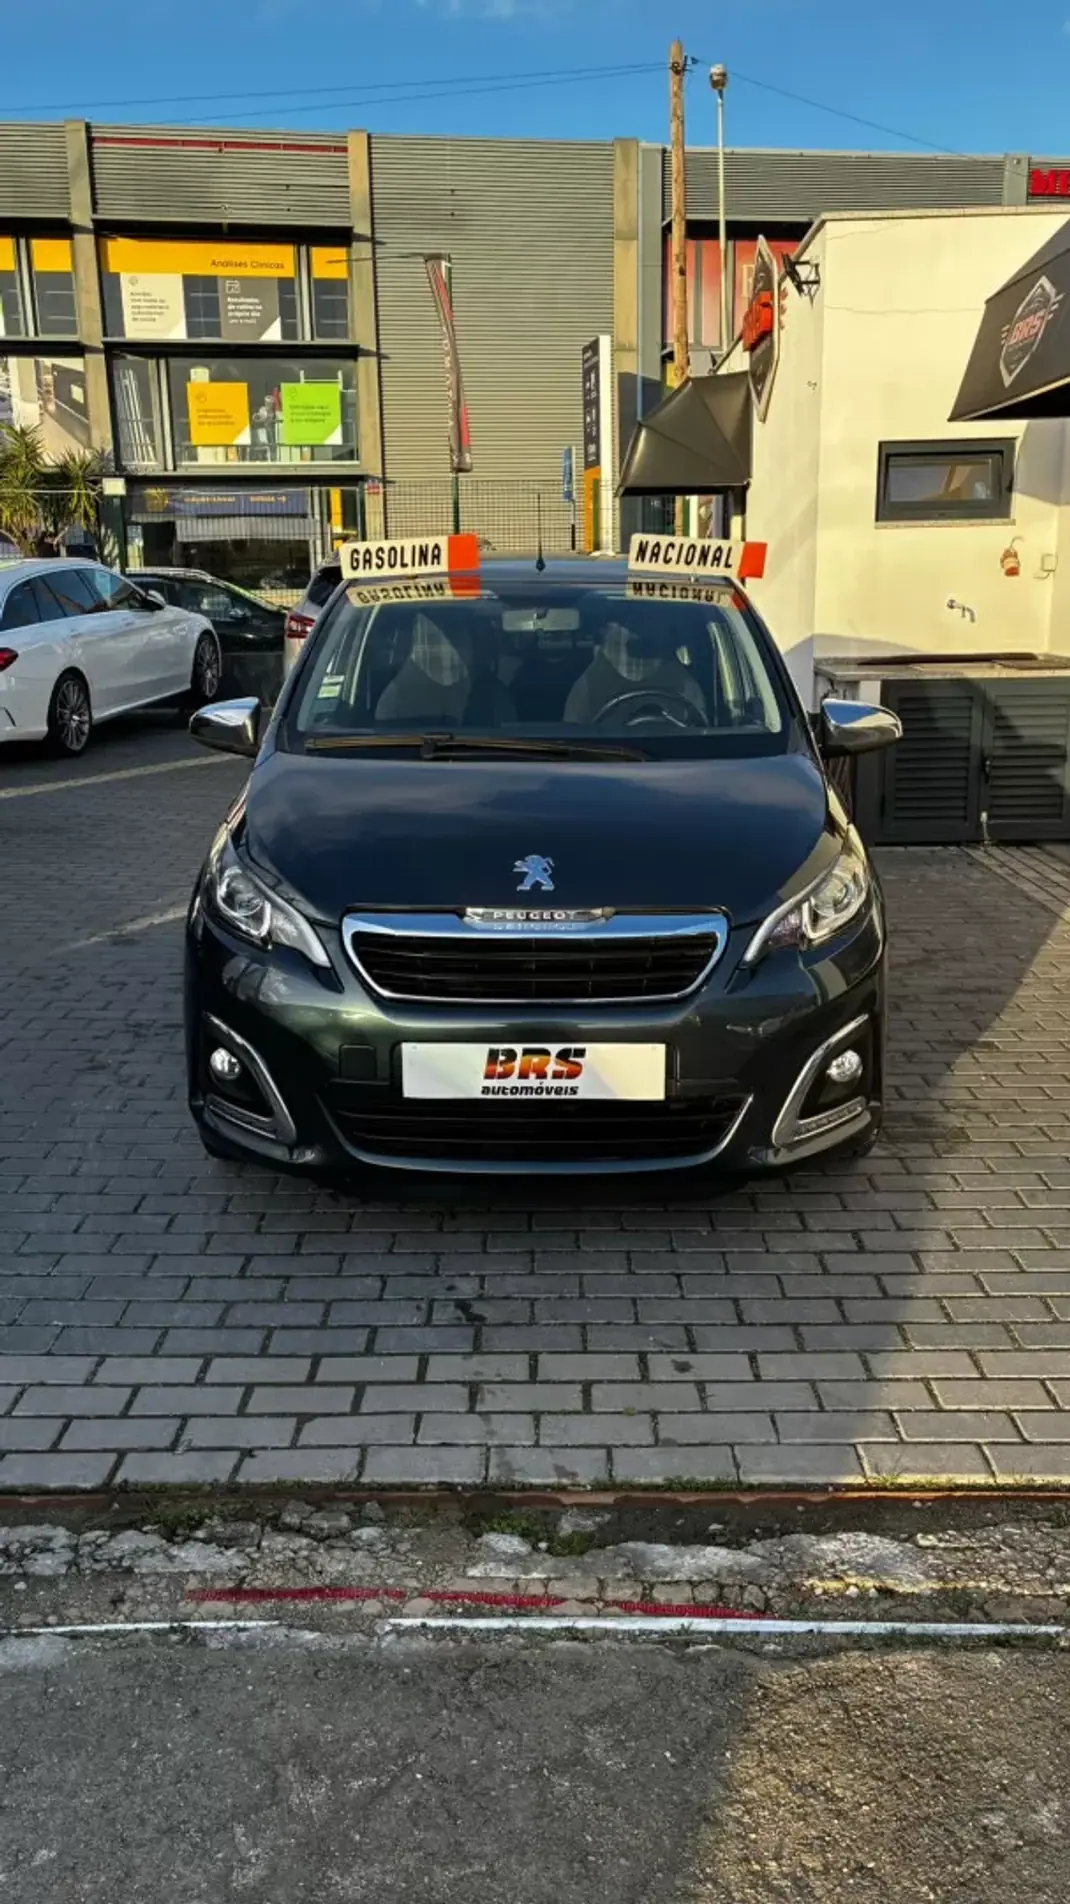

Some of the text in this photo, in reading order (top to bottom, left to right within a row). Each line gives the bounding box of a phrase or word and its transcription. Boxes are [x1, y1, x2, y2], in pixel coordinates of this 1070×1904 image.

[350, 543, 442, 571] GASOLINA
[635, 540, 733, 569] NACIONAL
[493, 910, 576, 920] PEUGEOT
[484, 1047, 586, 1080] BRS
[480, 1081, 580, 1096] automóveis
